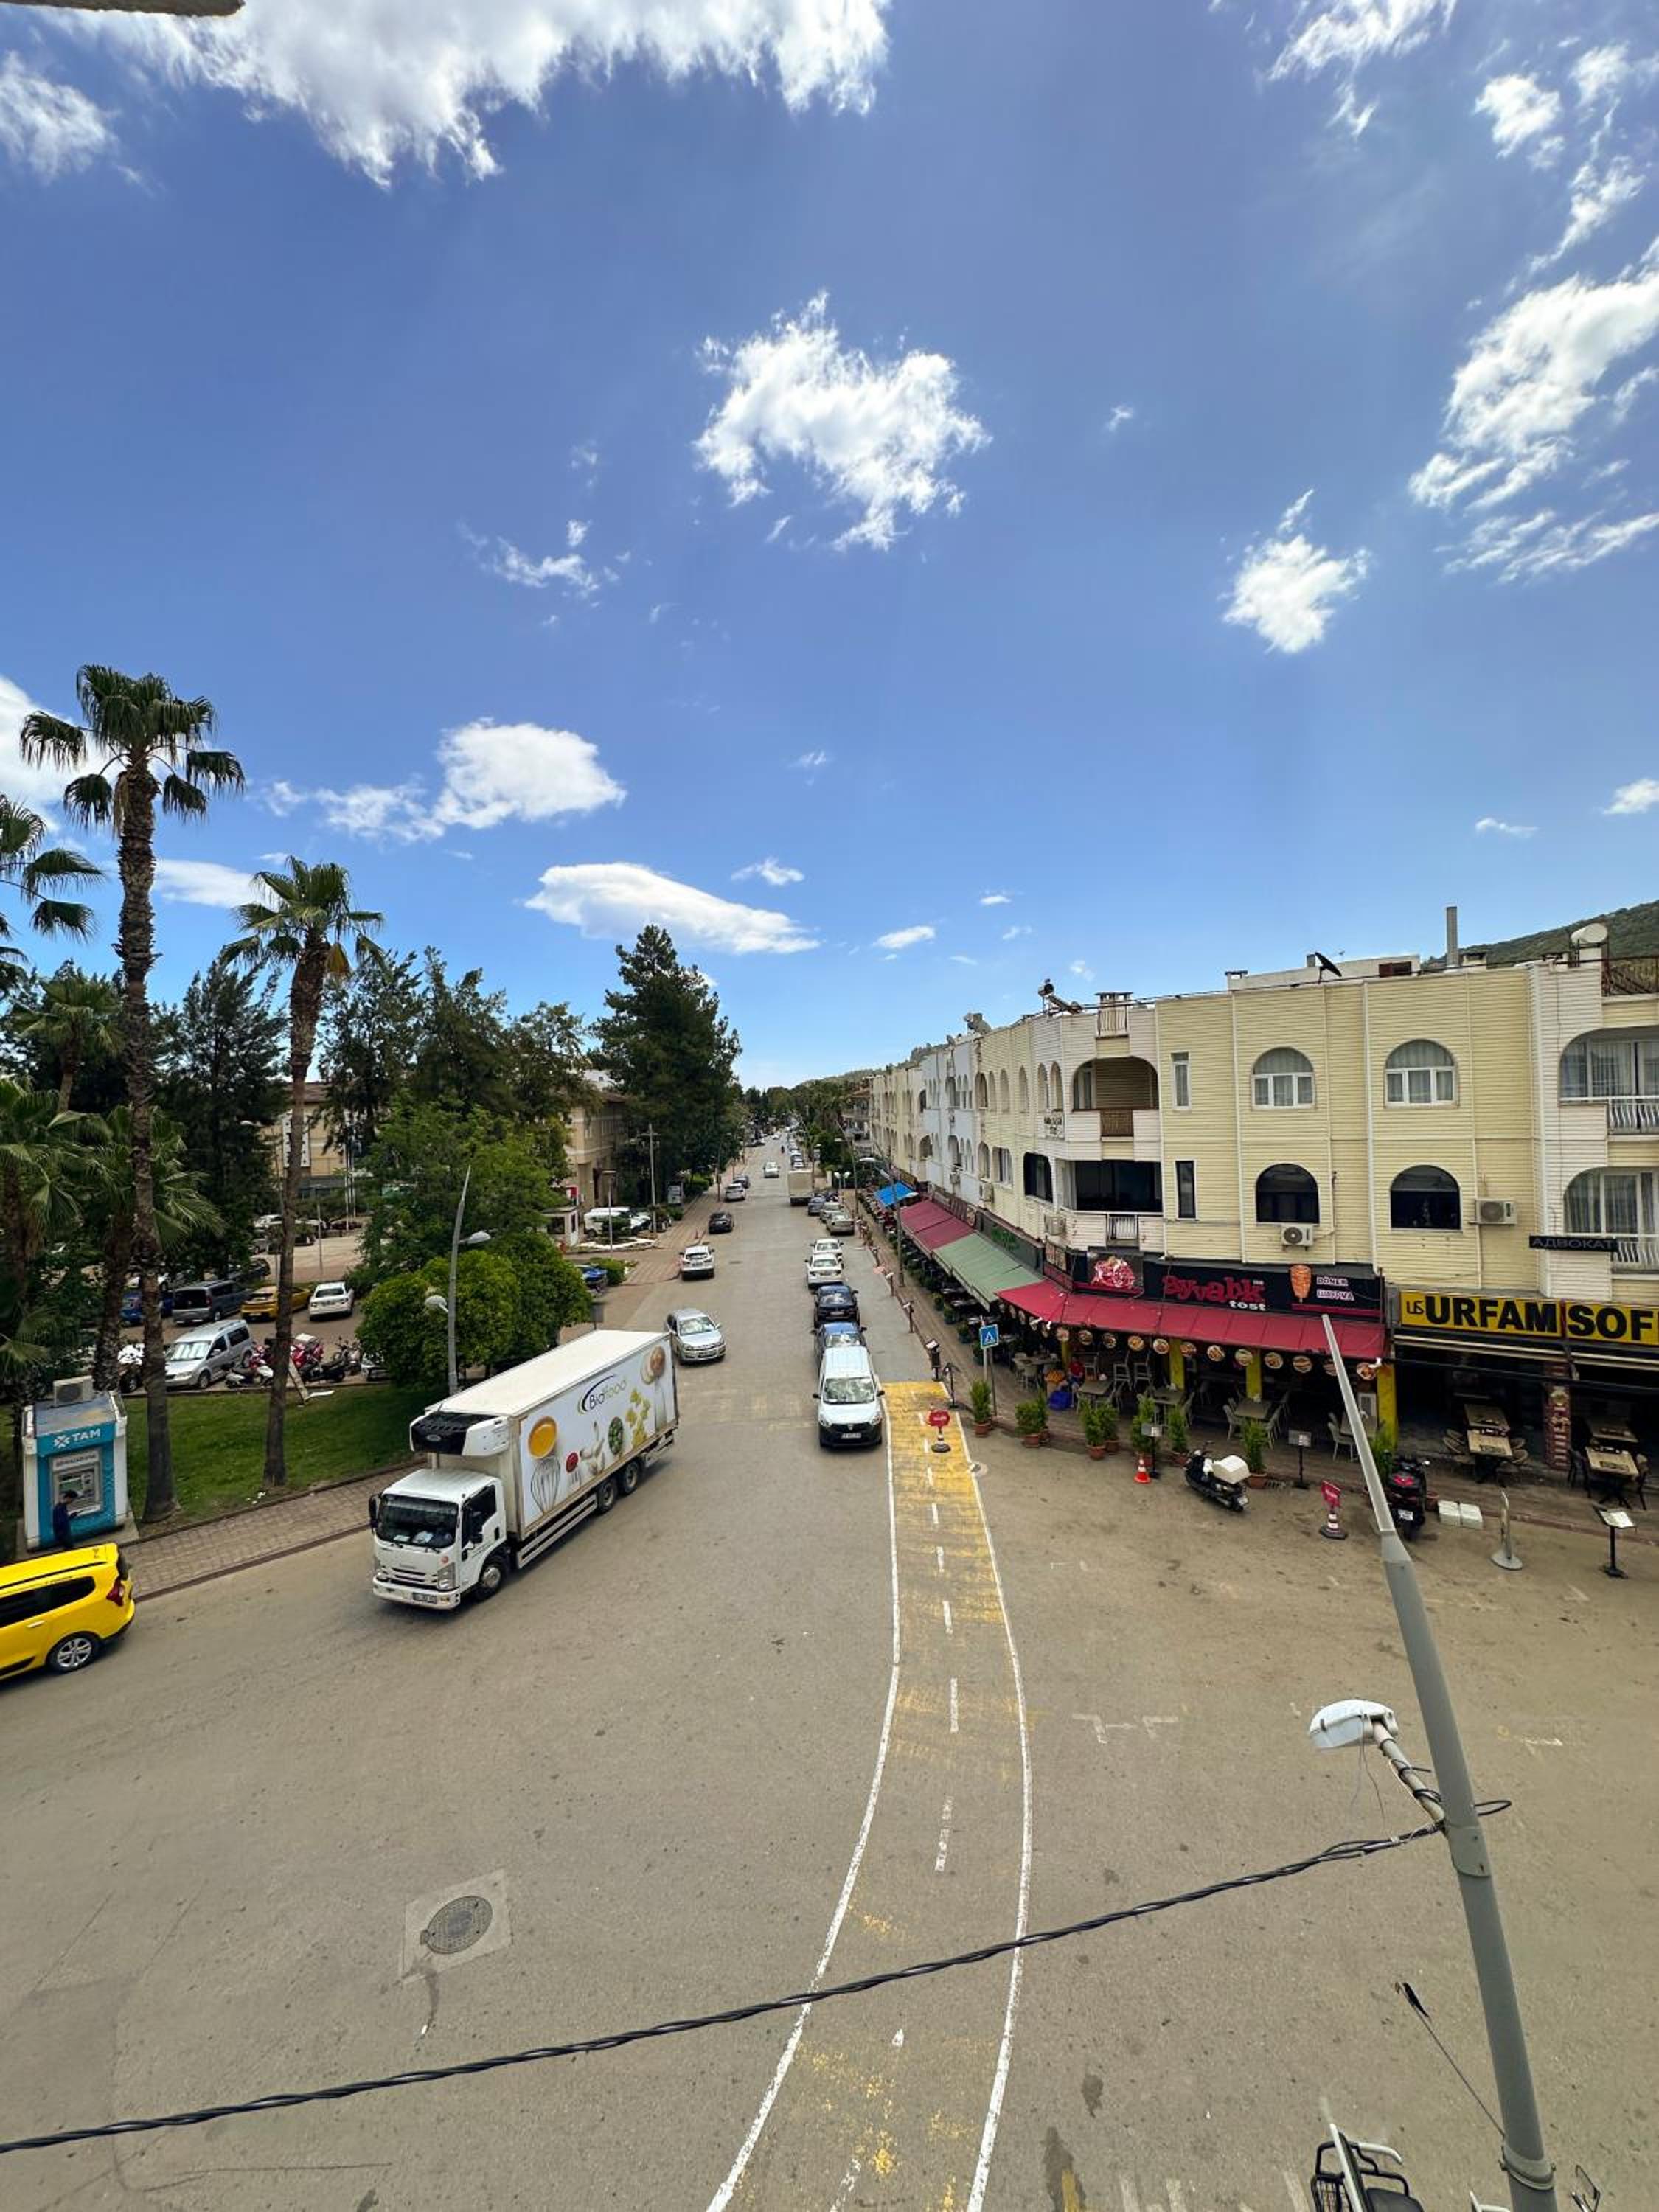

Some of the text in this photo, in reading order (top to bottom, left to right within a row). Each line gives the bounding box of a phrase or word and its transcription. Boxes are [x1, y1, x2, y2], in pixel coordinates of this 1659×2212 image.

[1532, 1237, 1613, 1249] АДВОКАТ
[1228, 1300, 1266, 1310] tost
[1425, 1295, 1557, 1333] URFAM
[1568, 1304, 1659, 1341] SOF
[71, 1427, 101, 1441] TAM
